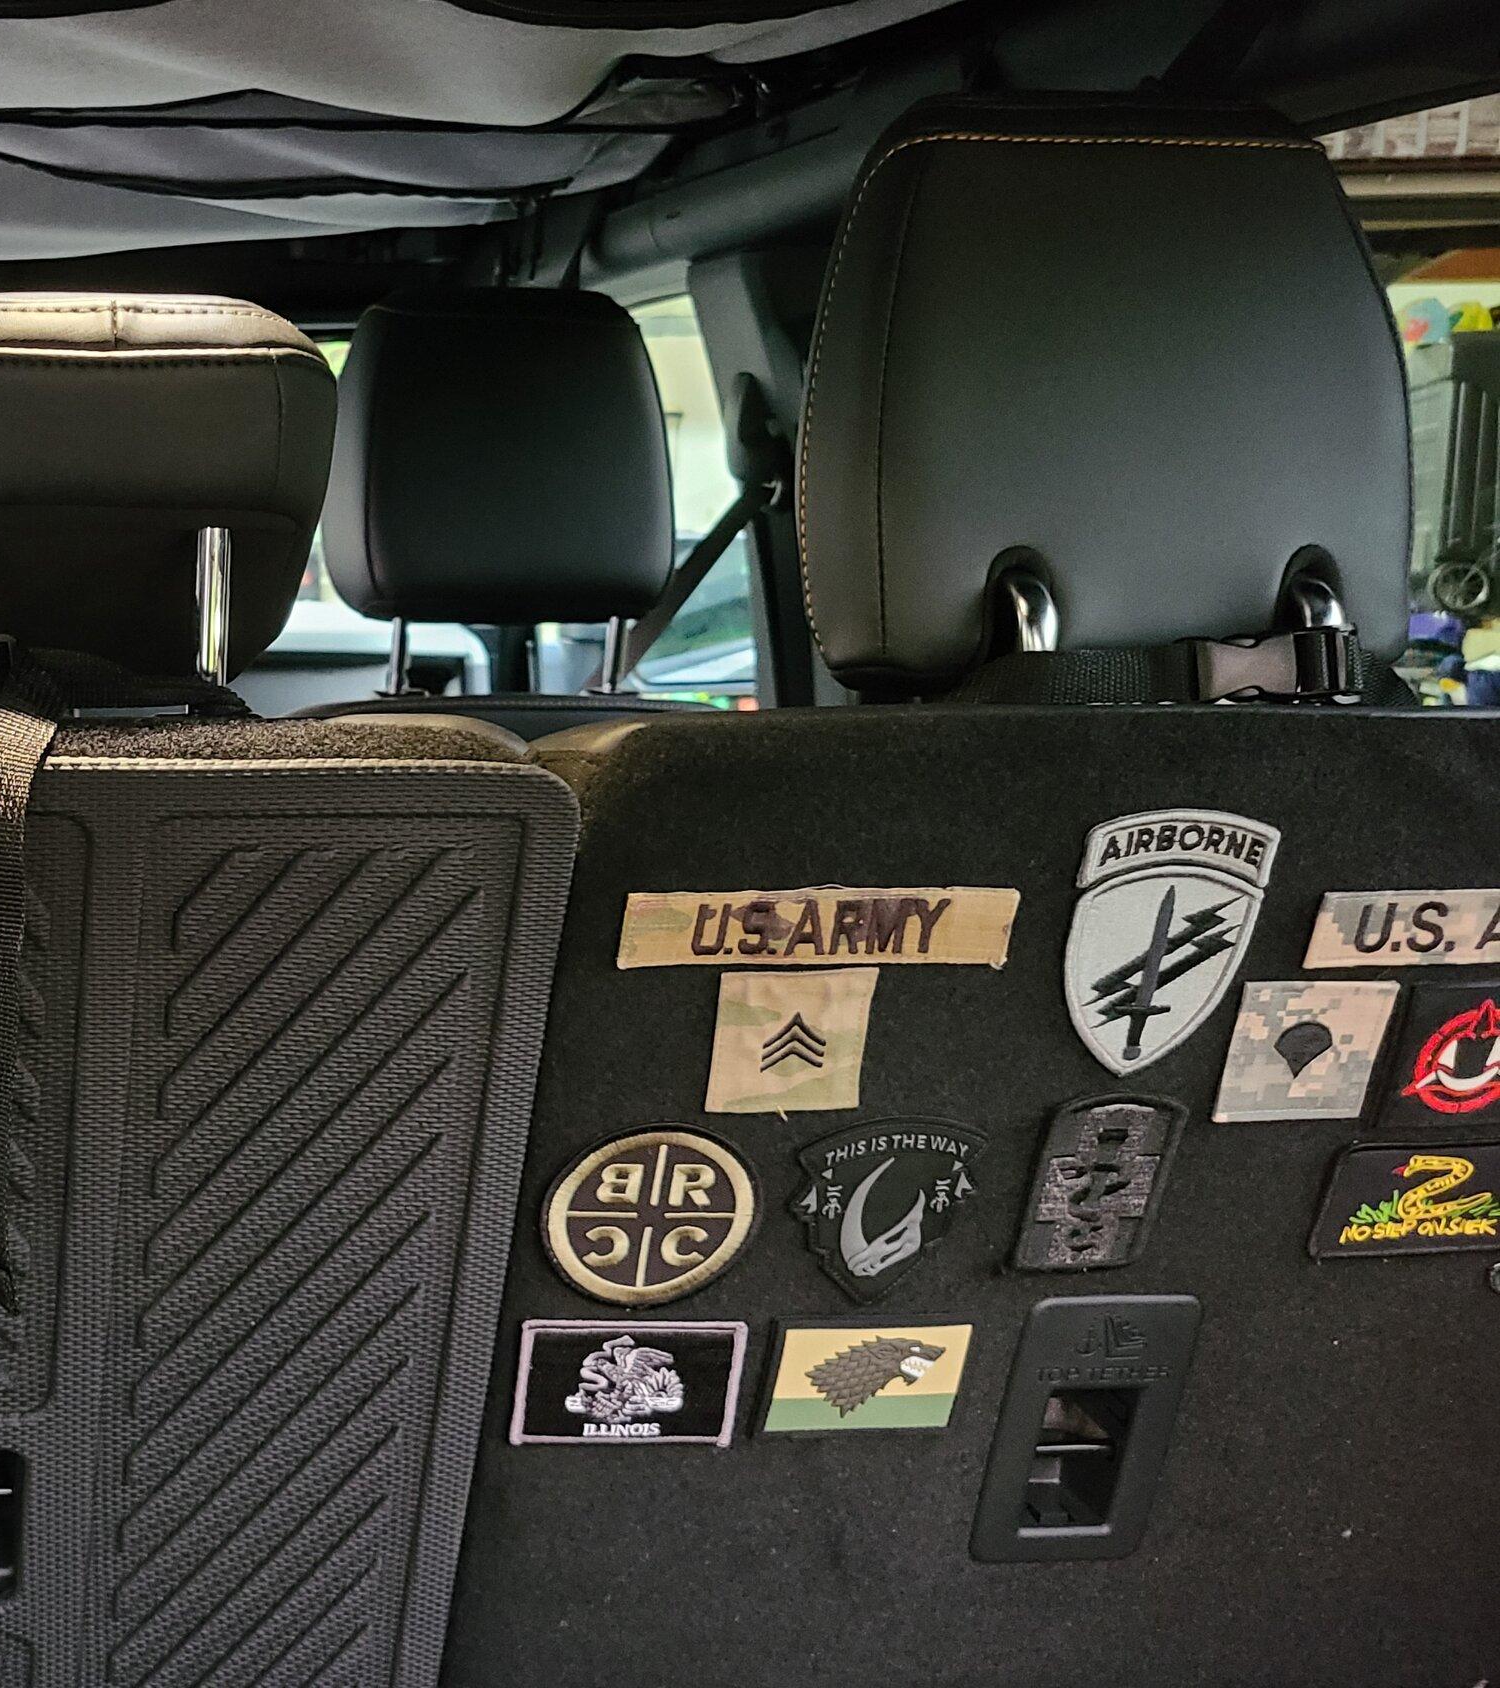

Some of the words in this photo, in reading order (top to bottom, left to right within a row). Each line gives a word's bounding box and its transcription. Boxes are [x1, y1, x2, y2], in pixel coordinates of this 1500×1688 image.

[1098, 824, 1267, 867] AIRBORNE
[1354, 901, 1455, 953] U.S.
[825, 1140, 867, 1167] THIS
[871, 1136, 888, 1152] IS
[891, 1134, 928, 1150] THE
[930, 1135, 969, 1158] WAY
[1339, 1223, 1371, 1245] NO
[1036, 1366, 1080, 1384] TOP
[583, 1422, 661, 1437] ILLINOIS
